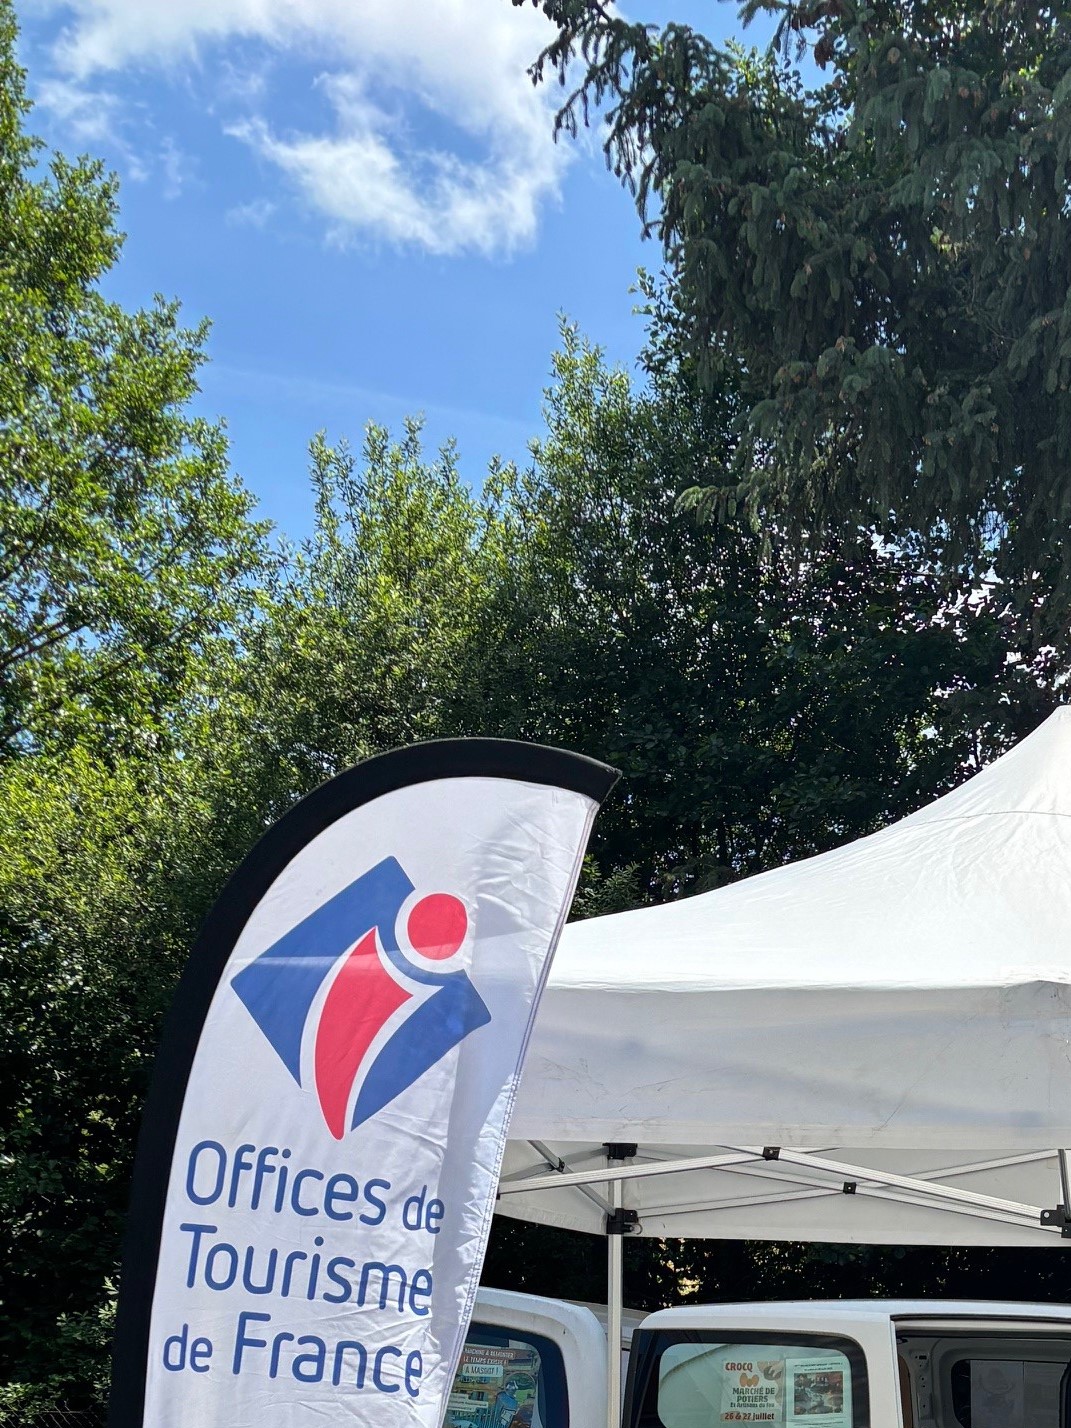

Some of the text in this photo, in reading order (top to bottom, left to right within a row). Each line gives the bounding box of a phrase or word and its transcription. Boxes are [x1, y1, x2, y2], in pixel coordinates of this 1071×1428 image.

[186, 1140, 445, 1234] Offices de
[180, 1222, 433, 1316] Tourisme
[163, 1311, 423, 1398] de France
[725, 1362, 753, 1373] CROCQ
[732, 1386, 775, 1395] MARCHÉ DE
[736, 1395, 769, 1403] POTIERS
[724, 1412, 734, 1420] 26
[752, 1412, 775, 1421] juillet
